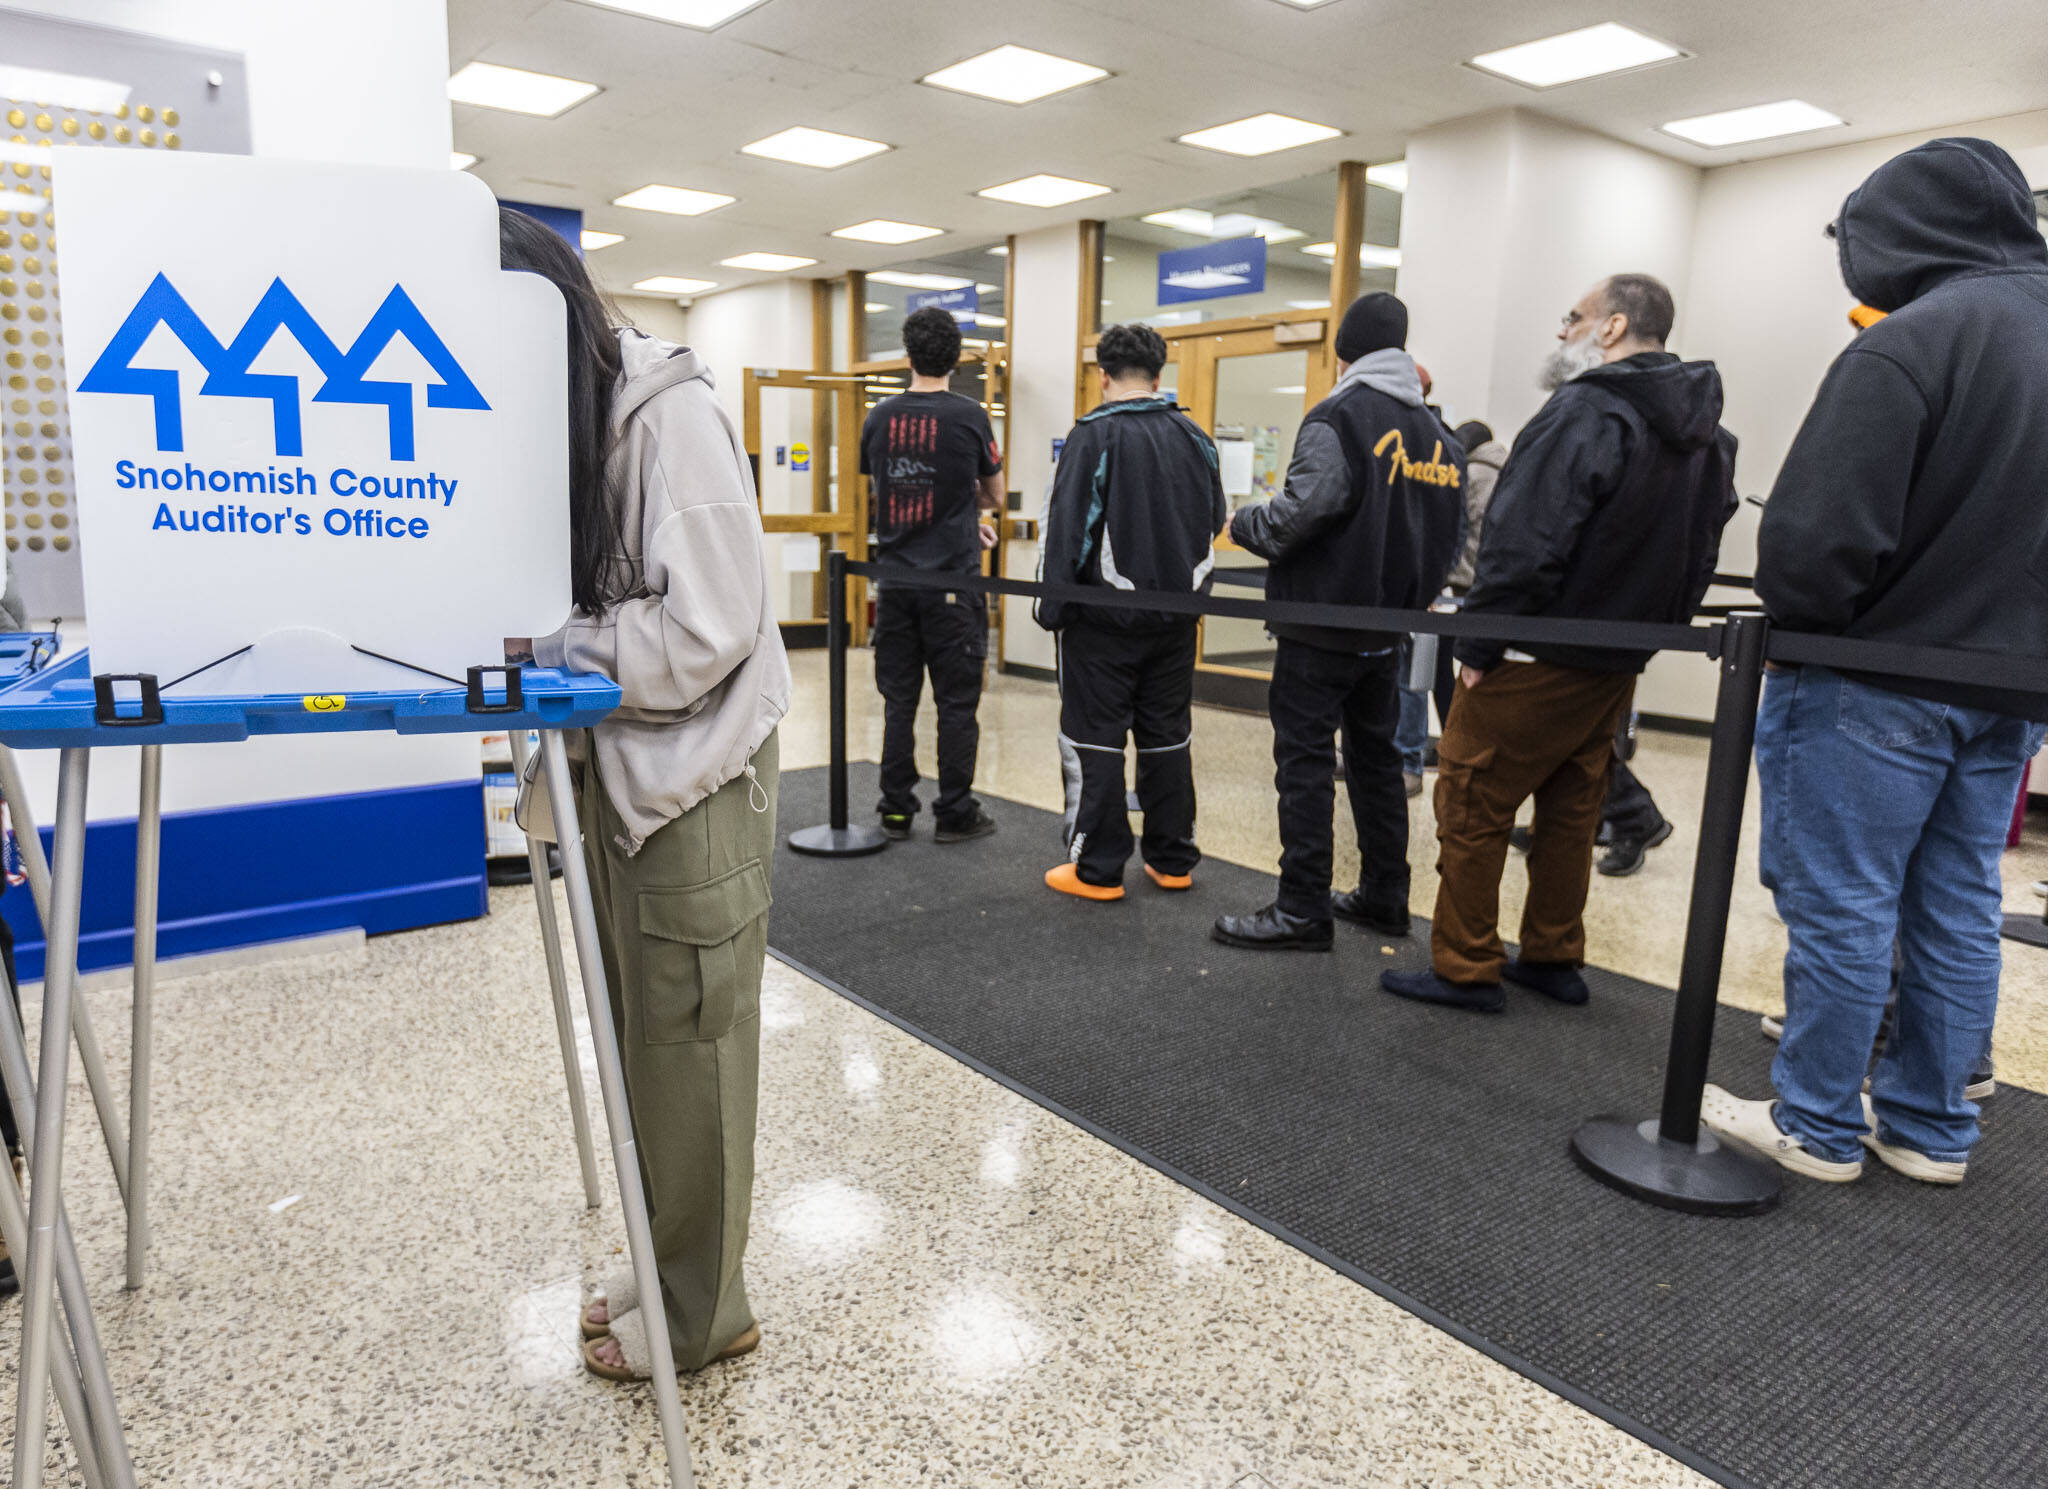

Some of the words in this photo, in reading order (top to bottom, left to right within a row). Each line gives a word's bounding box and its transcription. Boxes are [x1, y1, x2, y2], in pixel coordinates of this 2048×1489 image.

[1373, 429, 1460, 488] Fender
[115, 459, 317, 496] Snohomish
[329, 468, 459, 507] County
[151, 503, 312, 536] Auditor's
[323, 507, 430, 539] Office
